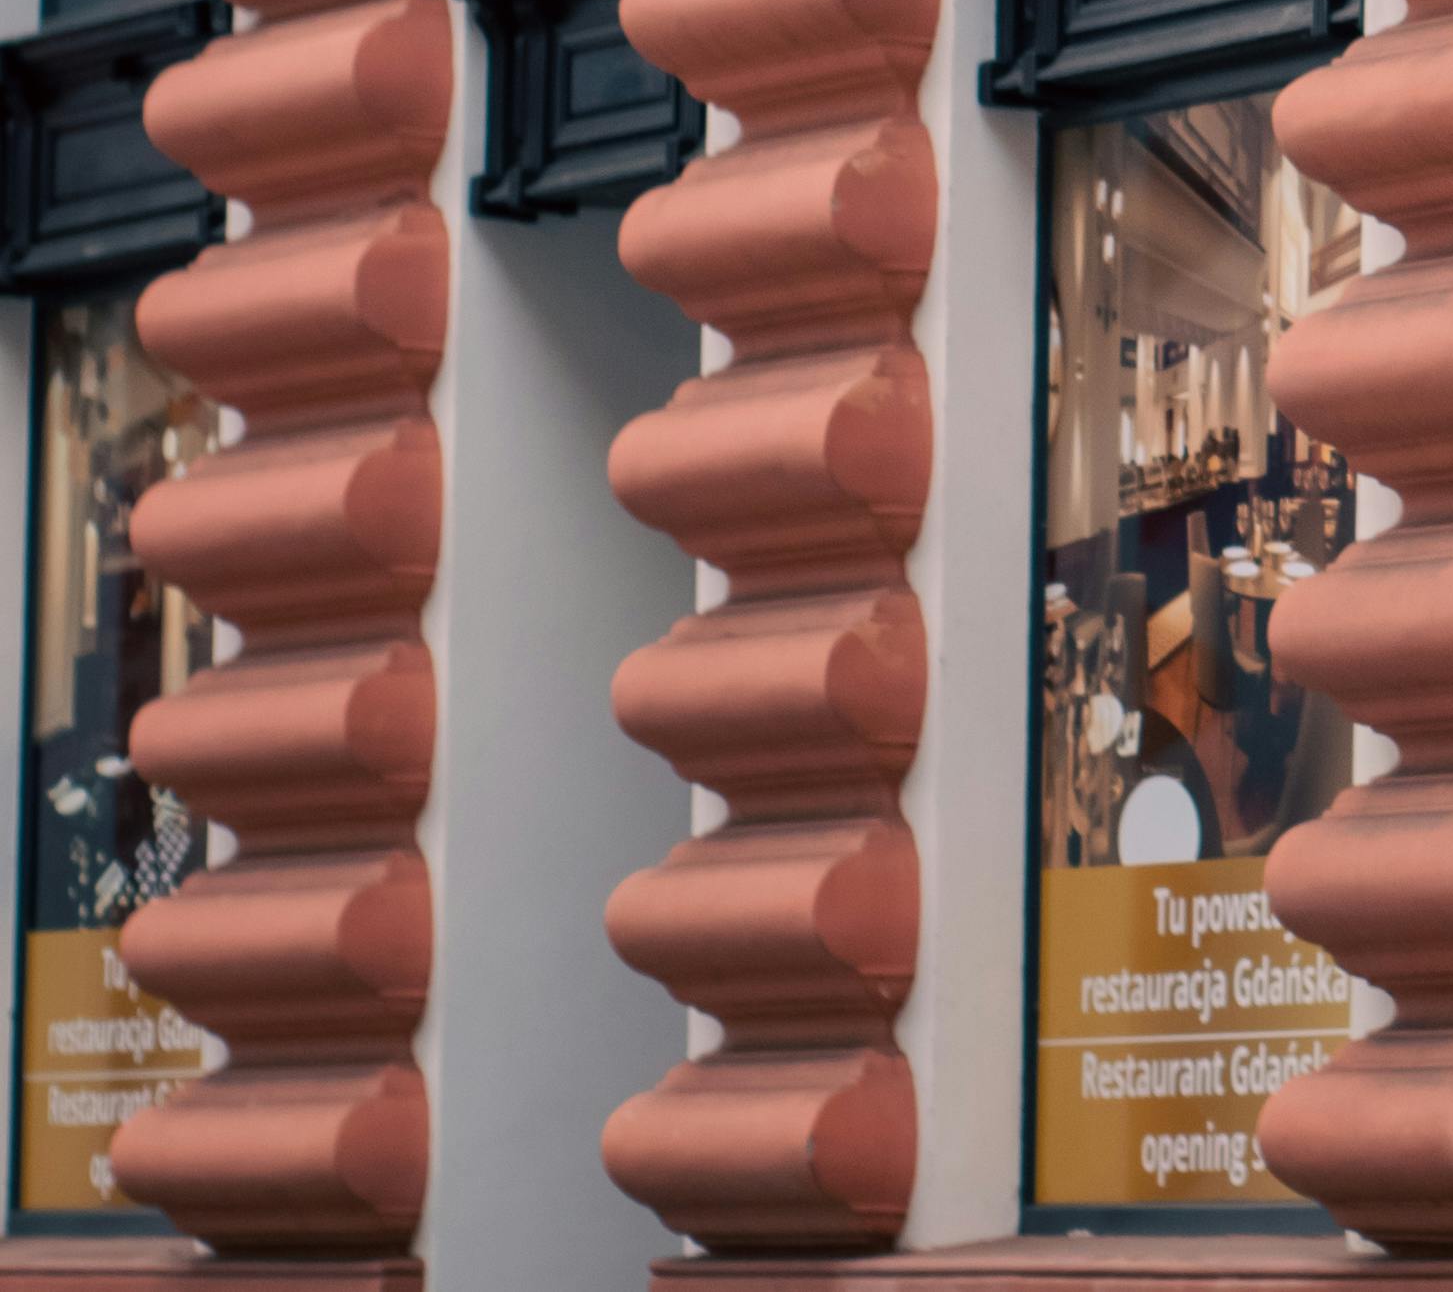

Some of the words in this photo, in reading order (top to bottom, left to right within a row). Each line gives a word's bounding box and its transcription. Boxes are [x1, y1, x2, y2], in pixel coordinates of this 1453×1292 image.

[1153, 886, 1187, 936] Tu
[1081, 957, 1228, 1025] restauracja
[1233, 951, 1349, 1009] Gdańska
[1081, 1049, 1226, 1100] Restaurant
[1141, 1119, 1249, 1188] opening
